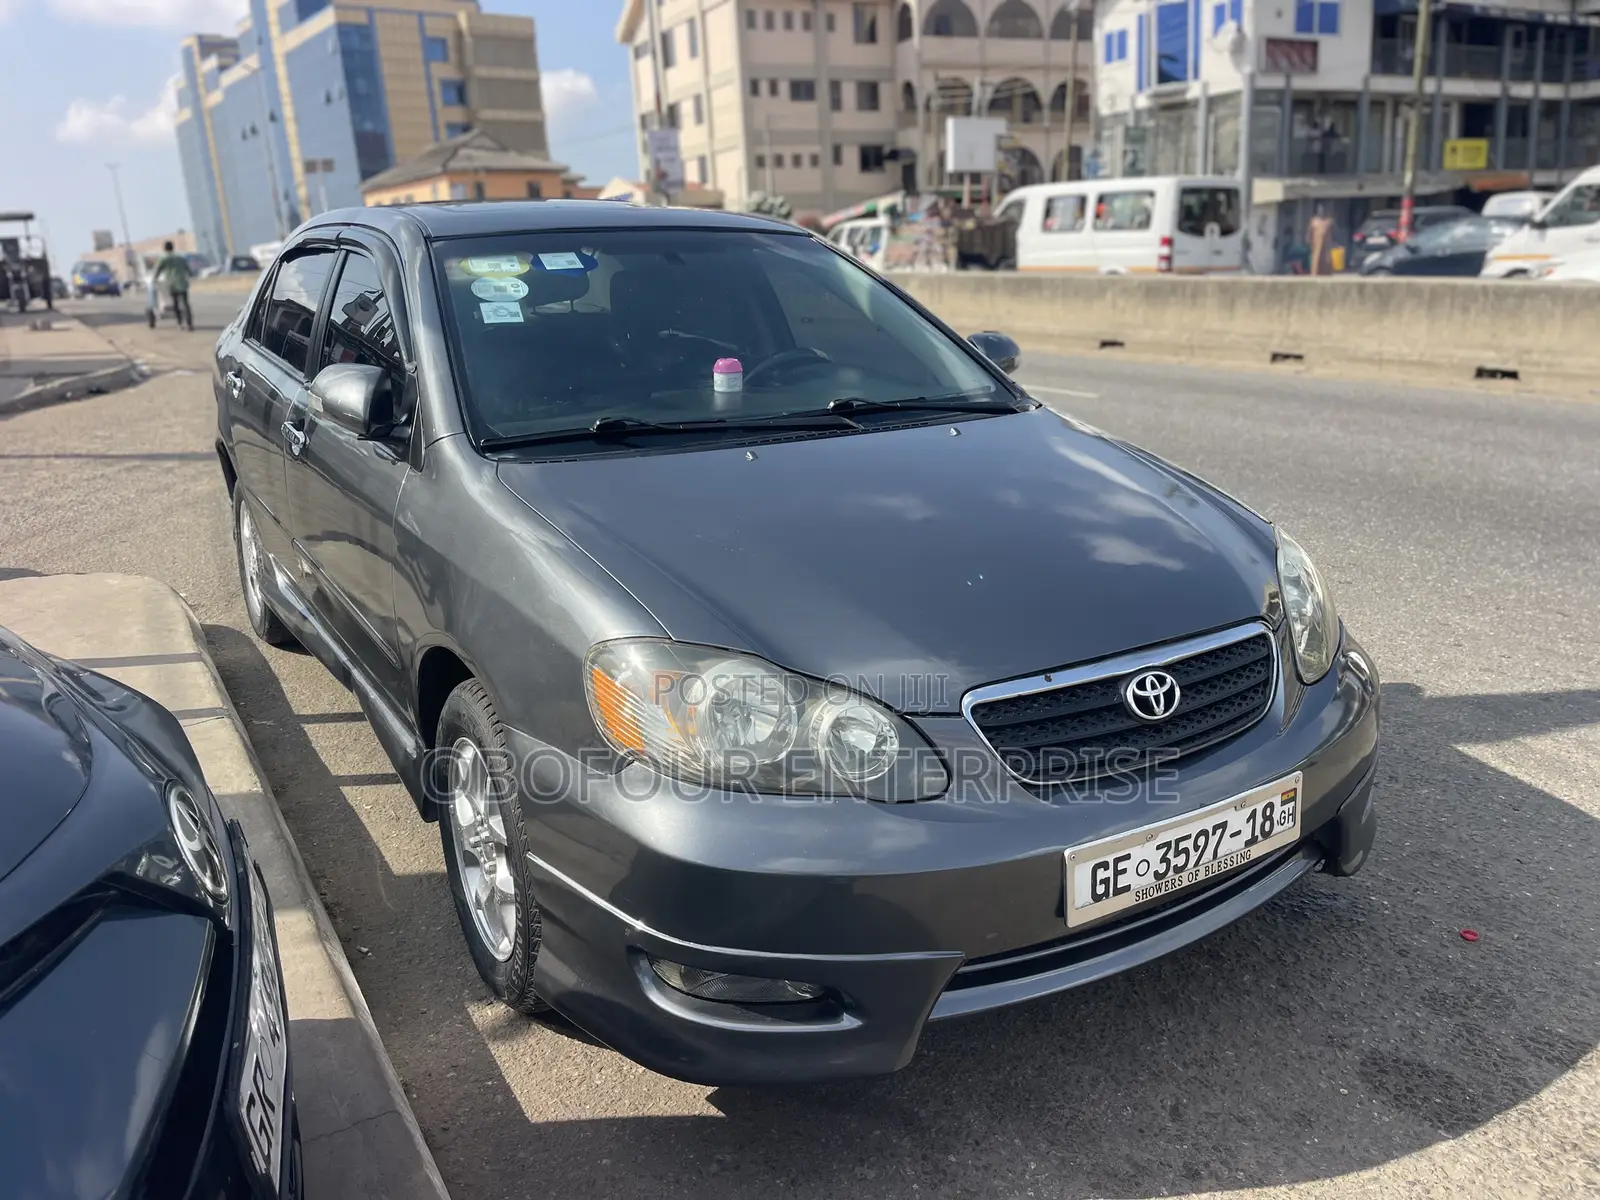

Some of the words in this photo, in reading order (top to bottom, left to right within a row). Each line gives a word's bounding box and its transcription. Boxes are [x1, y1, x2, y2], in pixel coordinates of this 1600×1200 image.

[1091, 853, 1131, 902] GE
[1154, 801, 1275, 881] 3597-18
[1280, 805, 1295, 826] GH
[1134, 875, 1183, 902] SHOWERS
[1187, 869, 1200, 883] OF
[1204, 849, 1252, 877] BLESSING
[246, 1055, 276, 1170] GR
